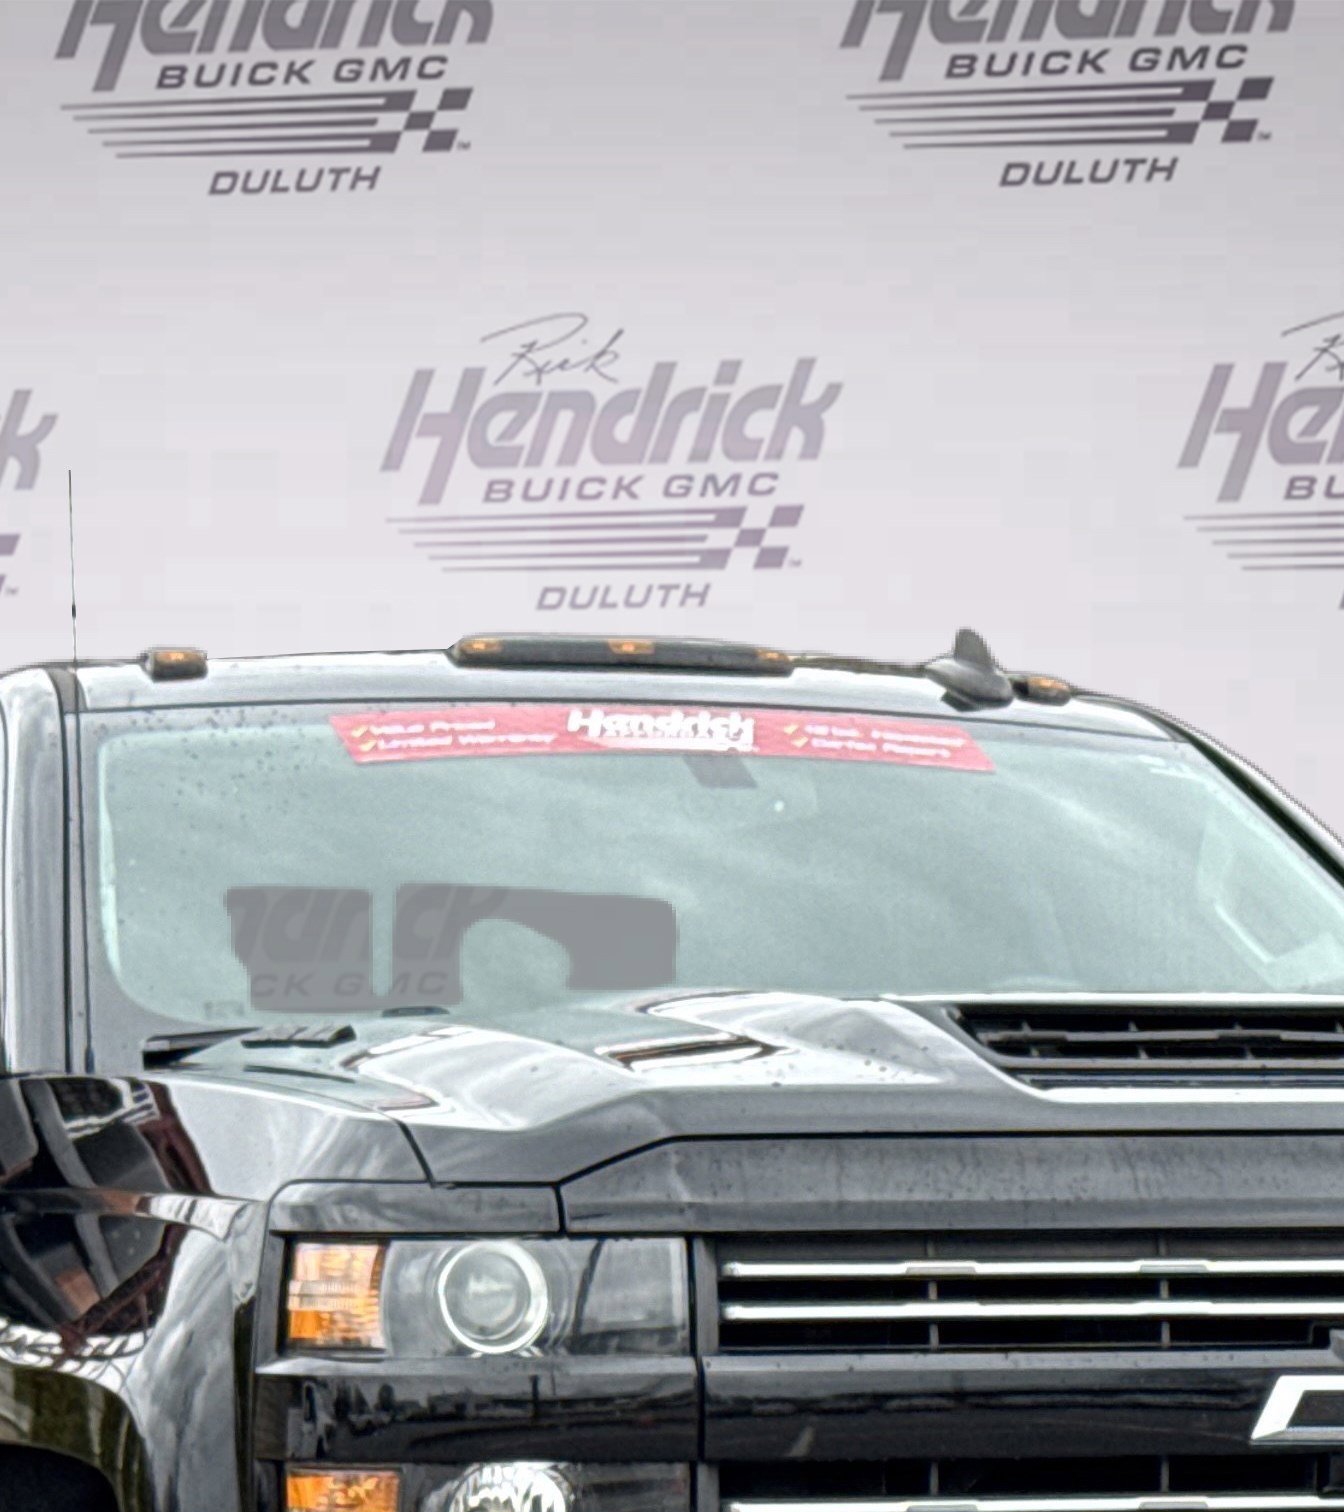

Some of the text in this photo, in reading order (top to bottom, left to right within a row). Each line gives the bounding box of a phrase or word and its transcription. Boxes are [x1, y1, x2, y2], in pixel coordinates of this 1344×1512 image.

[155, 55, 448, 90] BUICK GMC
[944, 44, 1248, 80] BUICK GMC
[207, 166, 382, 196] DULUTH
[998, 157, 1179, 188] DULUTH
[379, 357, 844, 506] Hendrick
[481, 472, 780, 504] BUICK GMC
[535, 582, 712, 611] DULUTH
